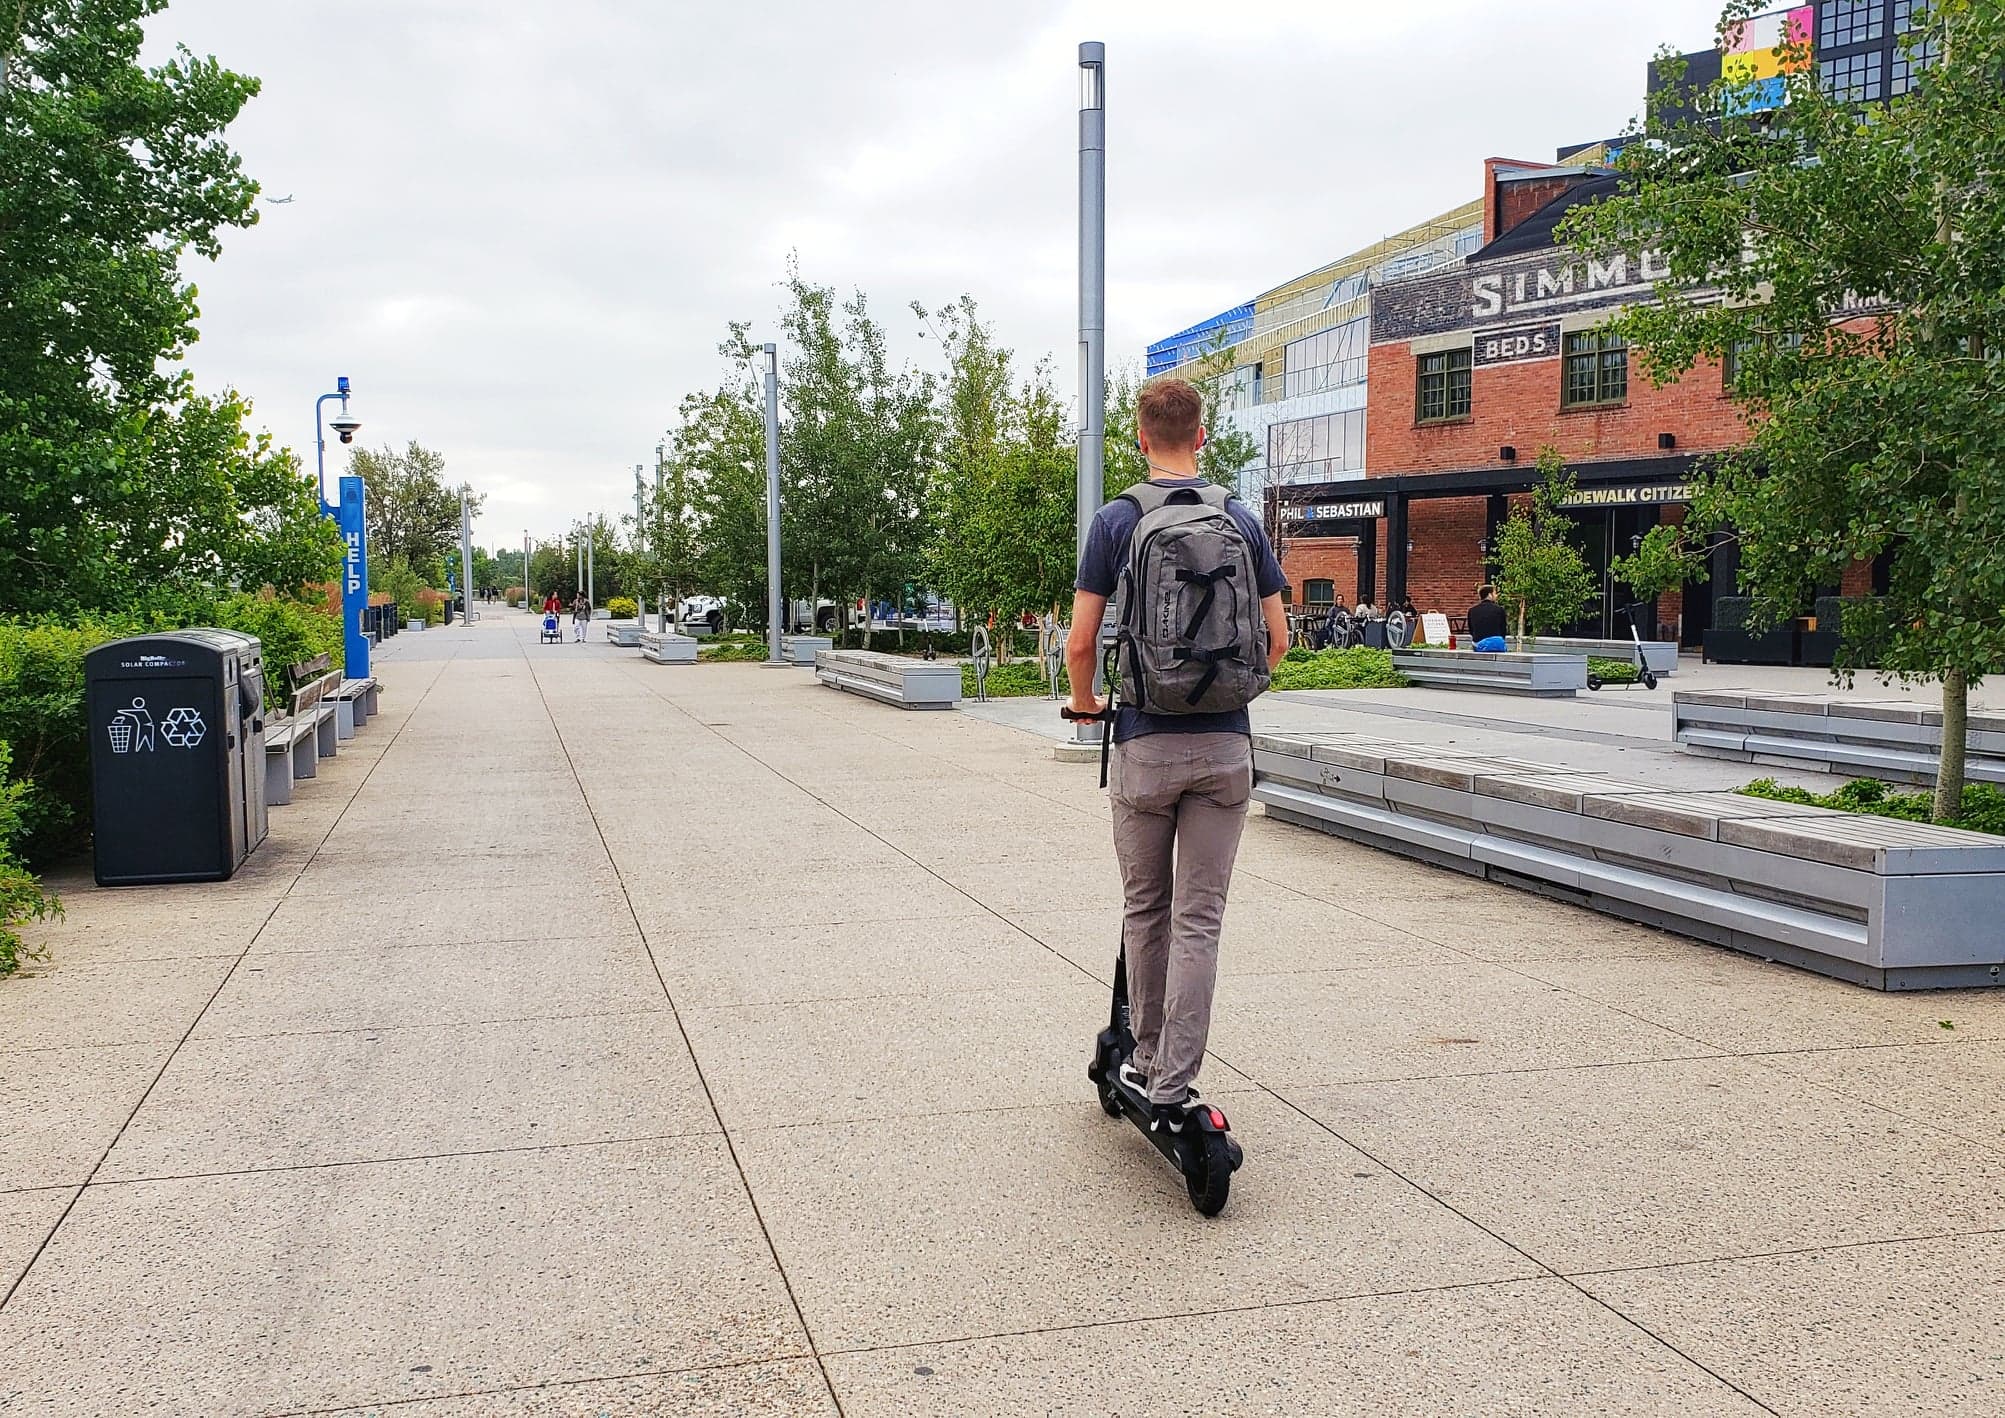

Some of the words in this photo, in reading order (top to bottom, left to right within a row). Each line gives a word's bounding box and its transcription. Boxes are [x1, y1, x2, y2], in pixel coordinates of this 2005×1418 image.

[1486, 332, 1546, 359] BEDS
[1281, 507, 1304, 520] PHIL
[1316, 502, 1381, 518] SEBASTIAN
[346, 532, 360, 594] HELP
[1162, 589, 1171, 639] DAKINE
